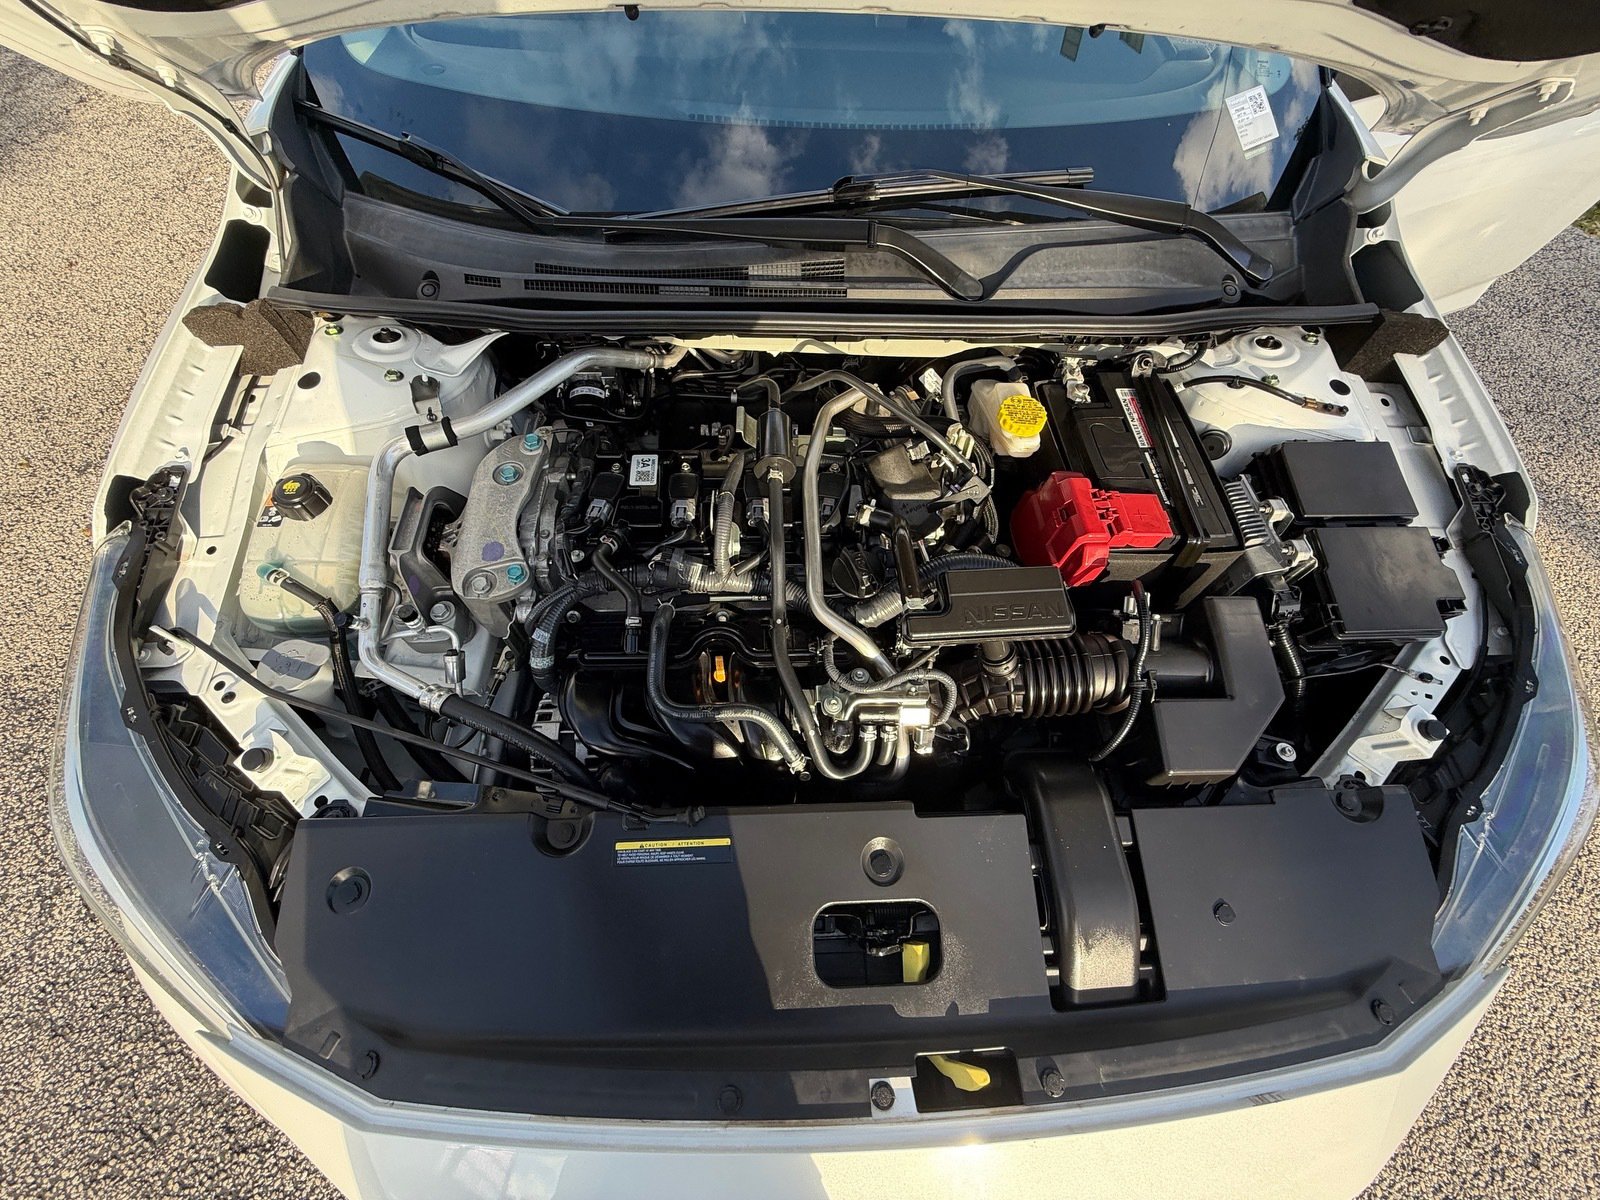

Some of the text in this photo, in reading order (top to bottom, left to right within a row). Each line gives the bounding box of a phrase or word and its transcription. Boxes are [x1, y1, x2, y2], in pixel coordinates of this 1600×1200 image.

[1121, 398, 1137, 423] NISSAN
[640, 457, 651, 469] 3A
[964, 602, 1064, 624] NISSAN
